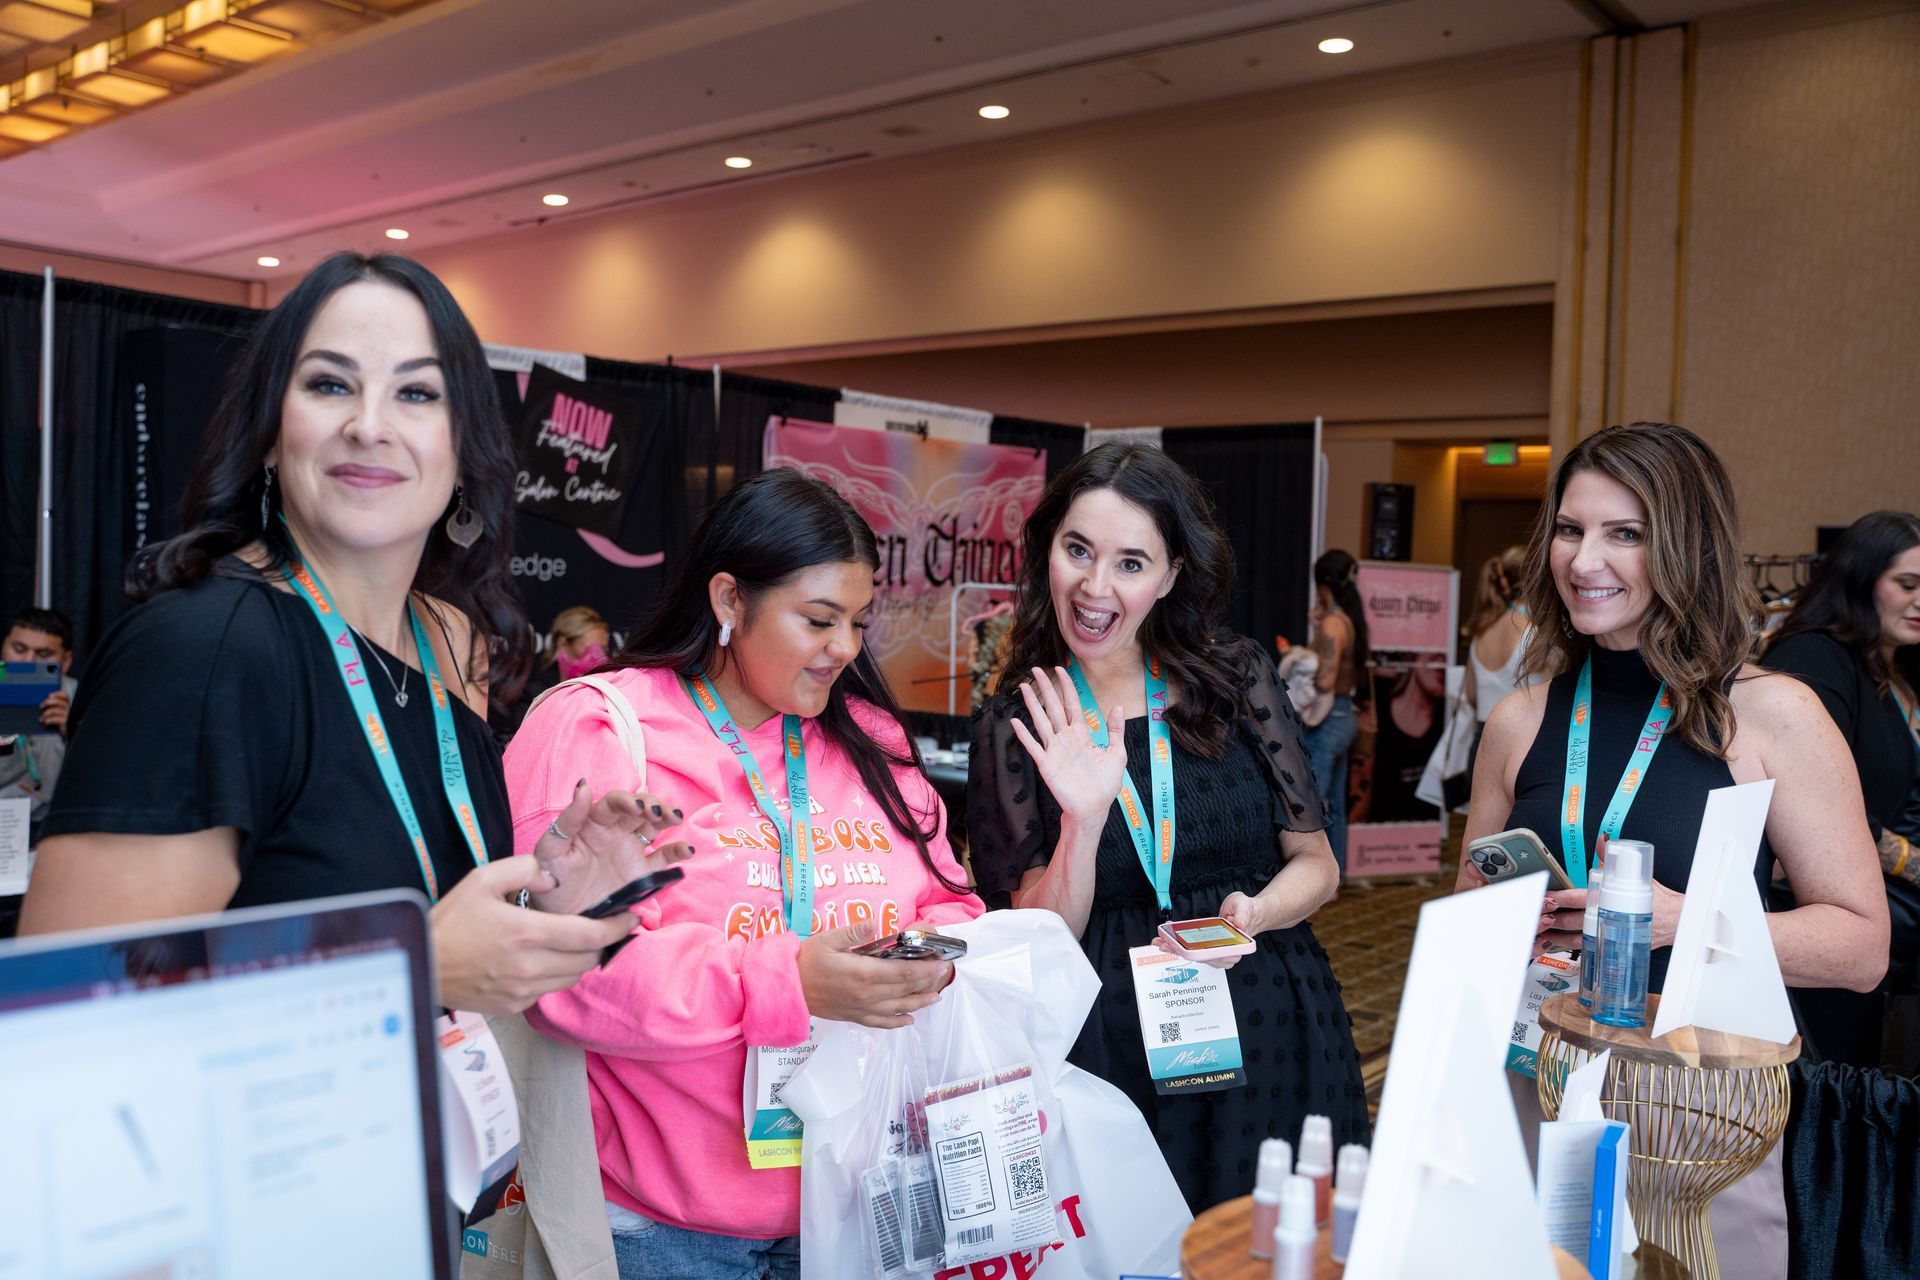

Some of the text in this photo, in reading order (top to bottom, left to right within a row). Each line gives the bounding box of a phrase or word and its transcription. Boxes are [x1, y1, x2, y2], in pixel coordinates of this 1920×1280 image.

[552, 392, 613, 450] NOW
[335, 631, 366, 686] PLA
[1151, 690, 1168, 722] PLA
[719, 720, 748, 755] PLA
[1637, 720, 1665, 753] PLA
[812, 818, 893, 853] BOSS
[843, 862, 887, 885] HER
[1149, 983, 1217, 1000] Sarah Pennington
[1165, 996, 1205, 1009] SPONSOR
[1165, 1072, 1236, 1089] LASHCON ALUMNI
[942, 1145, 982, 1161] Nutrition Facts
[953, 1140, 968, 1150] Lash
